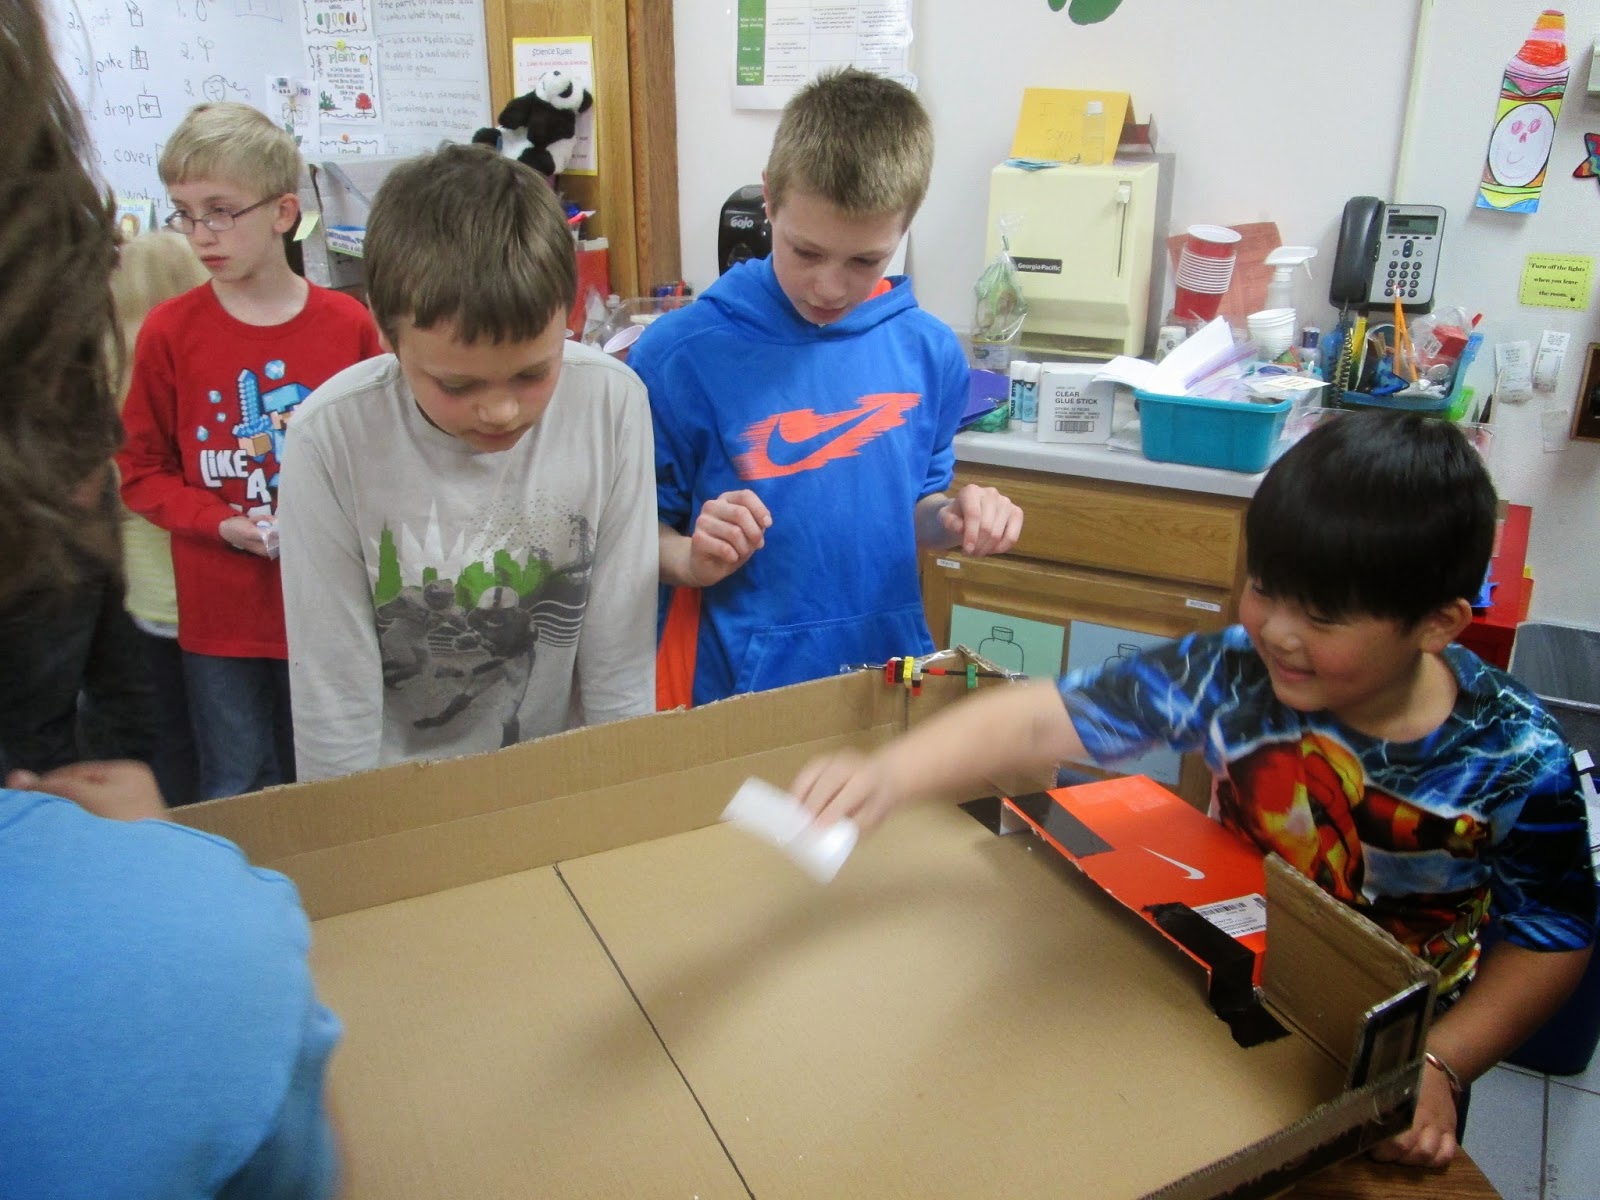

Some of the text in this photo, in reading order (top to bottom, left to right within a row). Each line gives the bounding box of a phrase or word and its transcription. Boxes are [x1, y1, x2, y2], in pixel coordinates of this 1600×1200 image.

[532, 47, 573, 57] Science Rules
[95, 52, 124, 87] poke
[104, 99, 134, 126] drop
[113, 148, 152, 166] cover
[200, 449, 249, 488] LiKE
[247, 468, 272, 503] A
